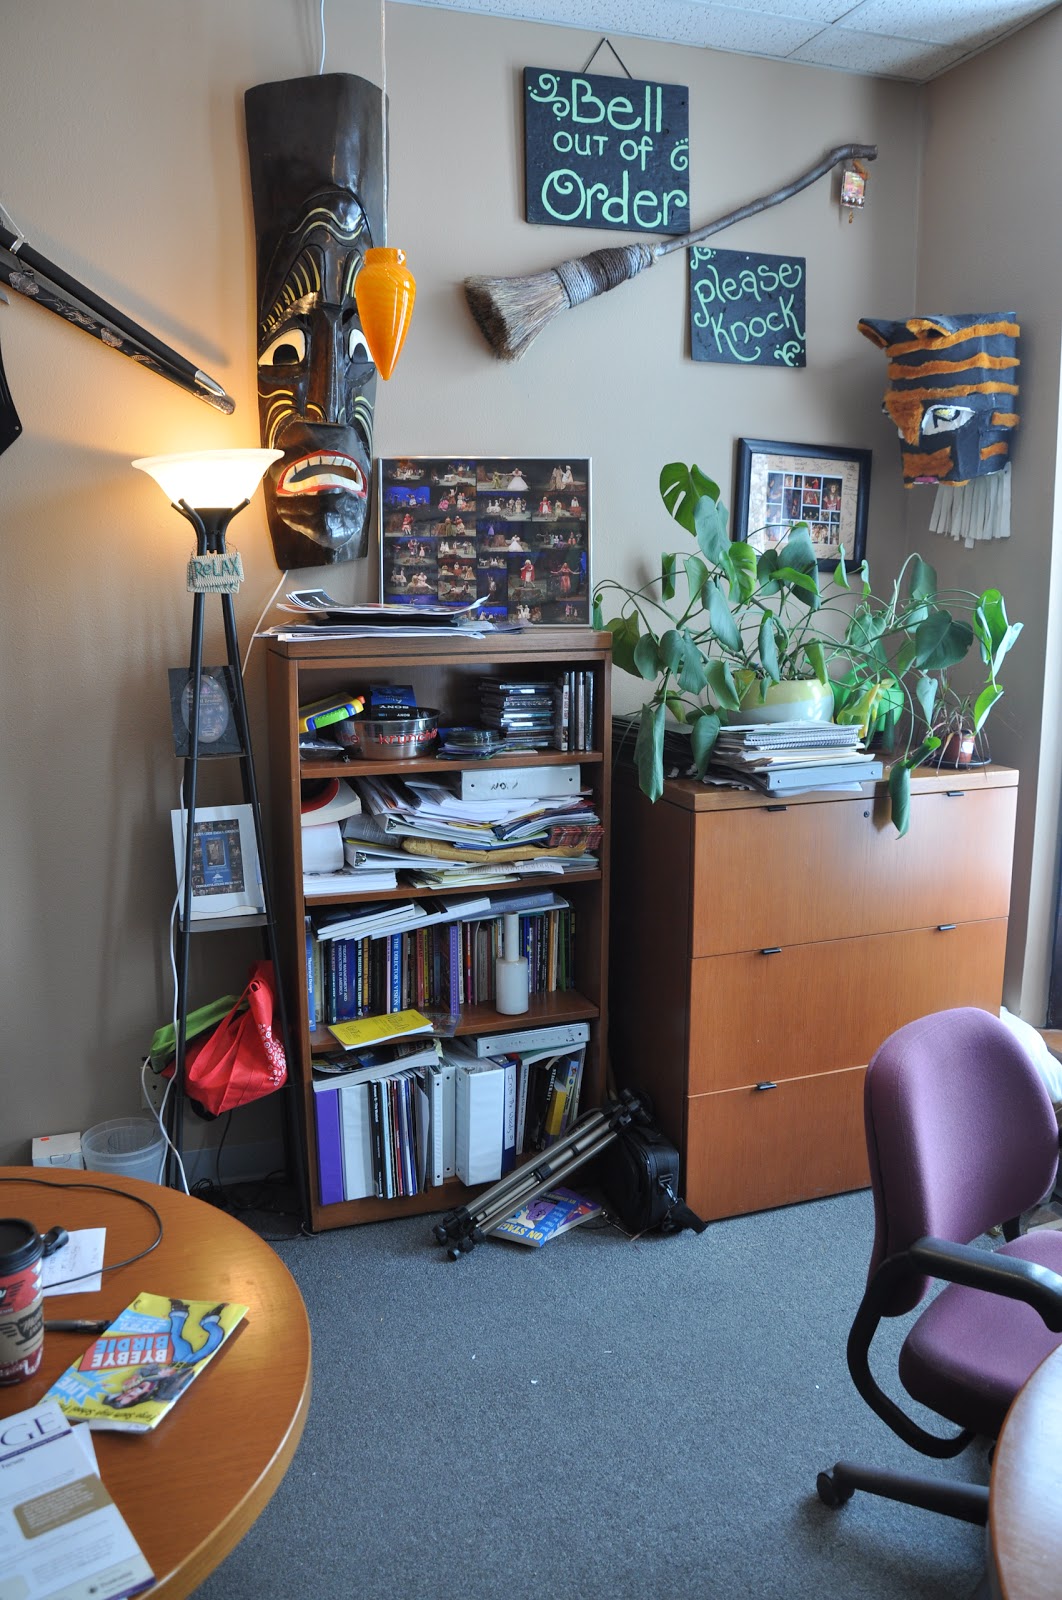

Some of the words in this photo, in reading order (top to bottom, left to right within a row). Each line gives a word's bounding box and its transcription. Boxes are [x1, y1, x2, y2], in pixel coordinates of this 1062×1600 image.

[572, 78, 662, 133] Bell
[619, 135, 653, 171] of
[541, 168, 688, 228] Order
[694, 263, 802, 328] please
[546, 1068, 557, 1102] STAGECRAFT
[526, 1229, 544, 1241] ON
[90, 1349, 168, 1367] BYEBYE
[93, 1335, 169, 1353] BIRDIE
[56, 1375, 91, 1401] LIVE
